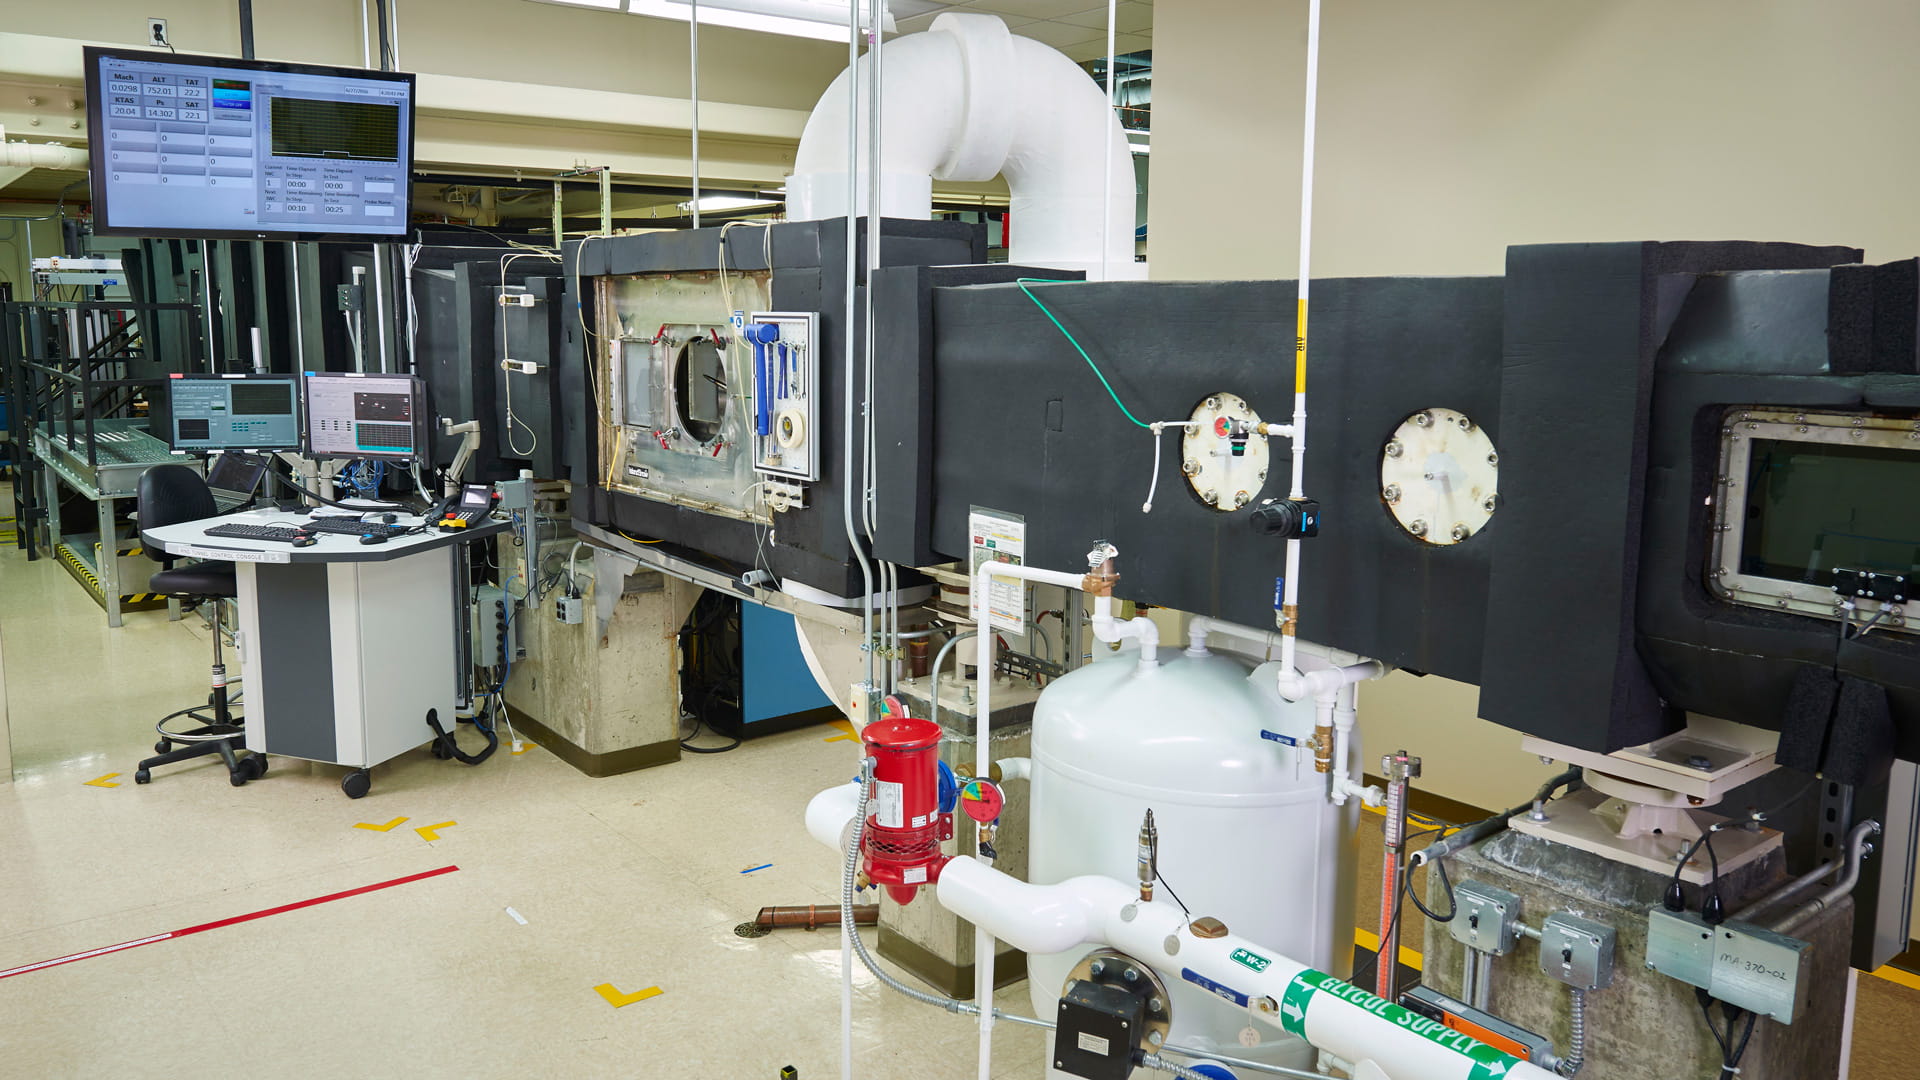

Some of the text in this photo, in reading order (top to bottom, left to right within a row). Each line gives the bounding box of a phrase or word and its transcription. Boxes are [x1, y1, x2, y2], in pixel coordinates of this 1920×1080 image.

[112, 84, 138, 93] 0.0298
[148, 87, 172, 95] 752.01
[115, 107, 136, 115] 20.04
[149, 109, 173, 118] 14.302
[1296, 337, 1305, 351] AIR
[1246, 955, 1266, 968] W-2
[1318, 977, 1483, 1054] GLYCOL SUPPLY
